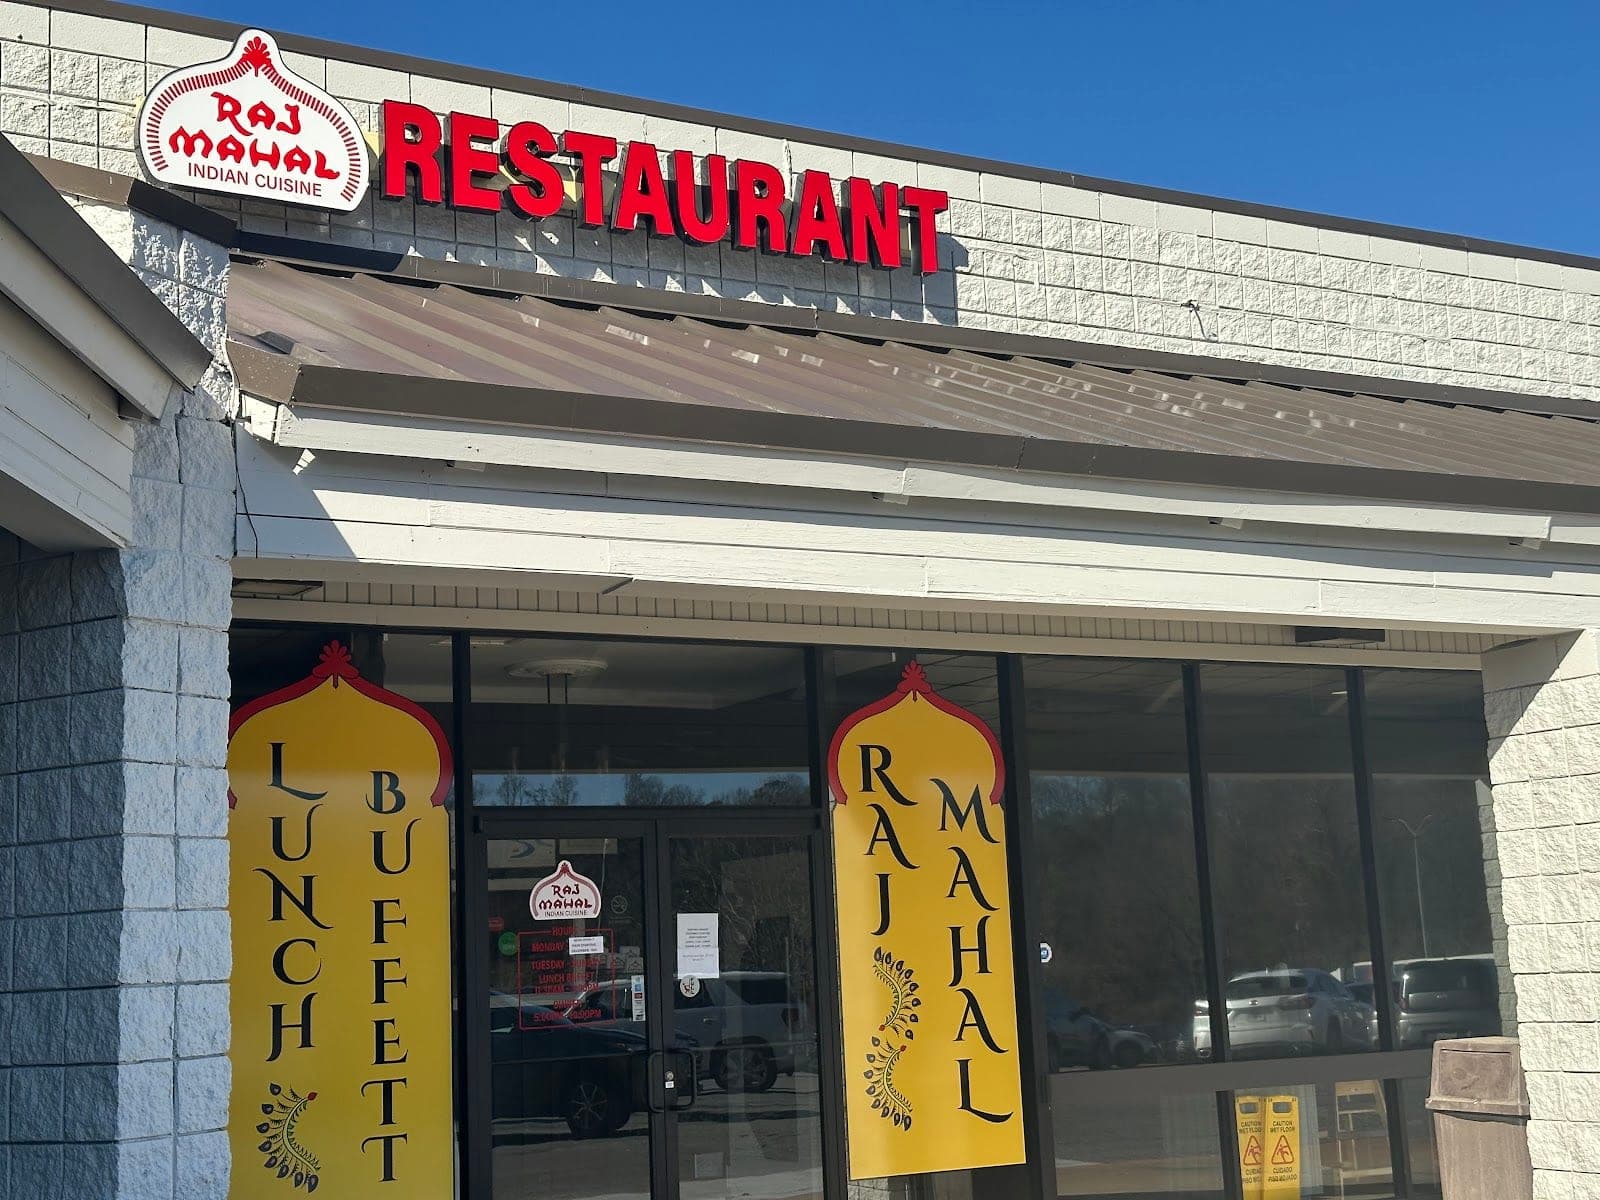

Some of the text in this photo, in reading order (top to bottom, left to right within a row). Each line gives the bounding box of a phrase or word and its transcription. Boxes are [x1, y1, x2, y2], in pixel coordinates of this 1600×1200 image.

[211, 92, 301, 137] RAJ
[168, 125, 341, 180] MAHAL
[187, 162, 322, 197] INDIAN CUISINE
[382, 99, 949, 275] RESTAURANT
[856, 744, 920, 936] RAJ
[253, 741, 333, 1062] LUNCH
[539, 898, 592, 910] MAHAL
[551, 884, 580, 898] RAJ
[532, 960, 565, 970] TUESDAY
[929, 777, 1014, 1123] MAHAL
[361, 770, 422, 1182] BUFFETT
[539, 973, 564, 983] LUNCH
